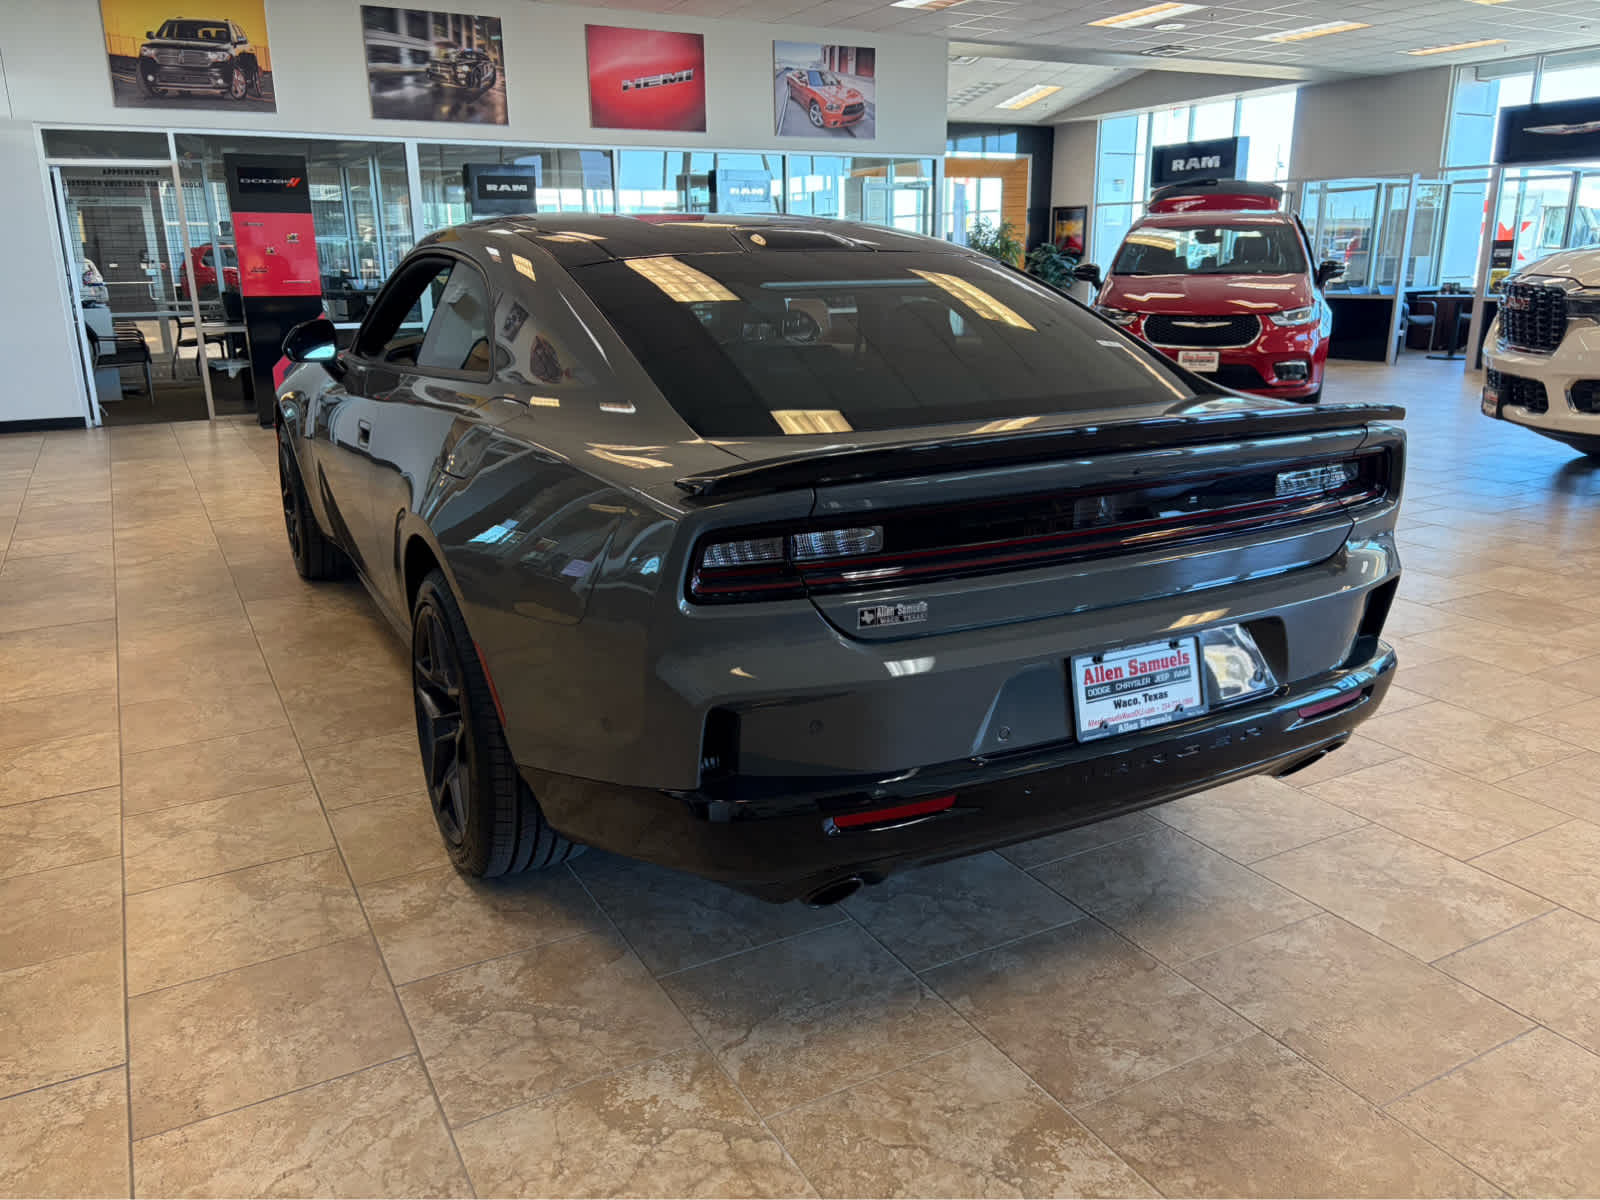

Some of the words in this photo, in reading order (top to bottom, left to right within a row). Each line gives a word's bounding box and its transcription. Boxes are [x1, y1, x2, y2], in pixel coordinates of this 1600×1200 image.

[622, 69, 694, 92] HEMI
[1171, 156, 1221, 171] RAM
[486, 184, 528, 192] RAM
[877, 606, 895, 617] Allen
[1083, 664, 1124, 685] Allen
[1128, 650, 1190, 676] Samuels
[1087, 685, 1111, 698] DODGE
[1115, 677, 1151, 690] CHRYSLER
[1154, 672, 1170, 683] JEEP
[1113, 697, 1141, 710] Waco,
[1142, 691, 1169, 703] Texas
[1118, 721, 1138, 733] Allen
[1140, 714, 1172, 729] Samuels
